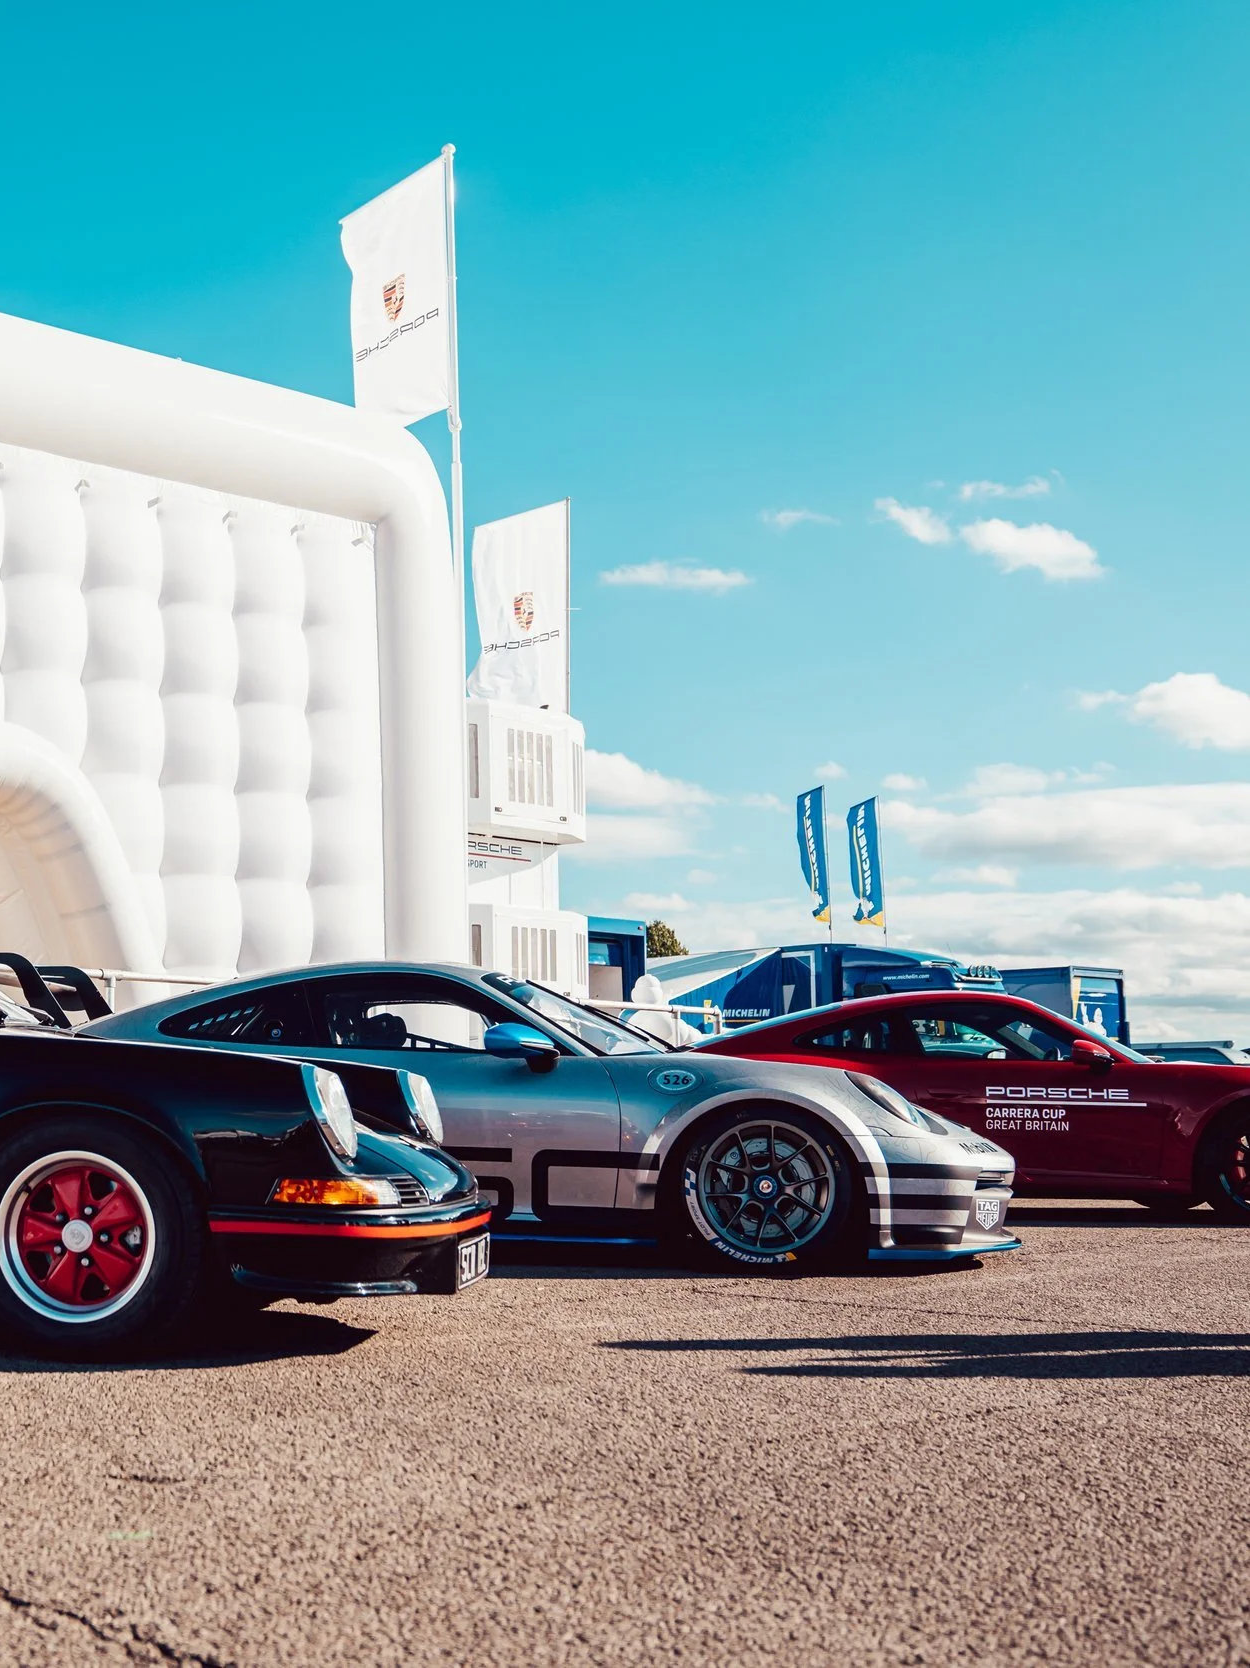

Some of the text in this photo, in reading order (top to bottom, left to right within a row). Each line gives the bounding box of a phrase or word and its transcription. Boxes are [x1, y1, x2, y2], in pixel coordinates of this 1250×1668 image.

[468, 840, 523, 856] RSCHE
[722, 1008, 770, 1018] MICHELIN
[662, 1074, 690, 1085] 526
[985, 1086, 1129, 1100] PORSCHE
[985, 1107, 1066, 1120] CARRERA CUP
[985, 1119, 1069, 1132] GREAT BRITAIN
[979, 1201, 998, 1211] TAG
[978, 1212, 999, 1228] HEUER
[714, 1241, 773, 1264] MICHELIN
